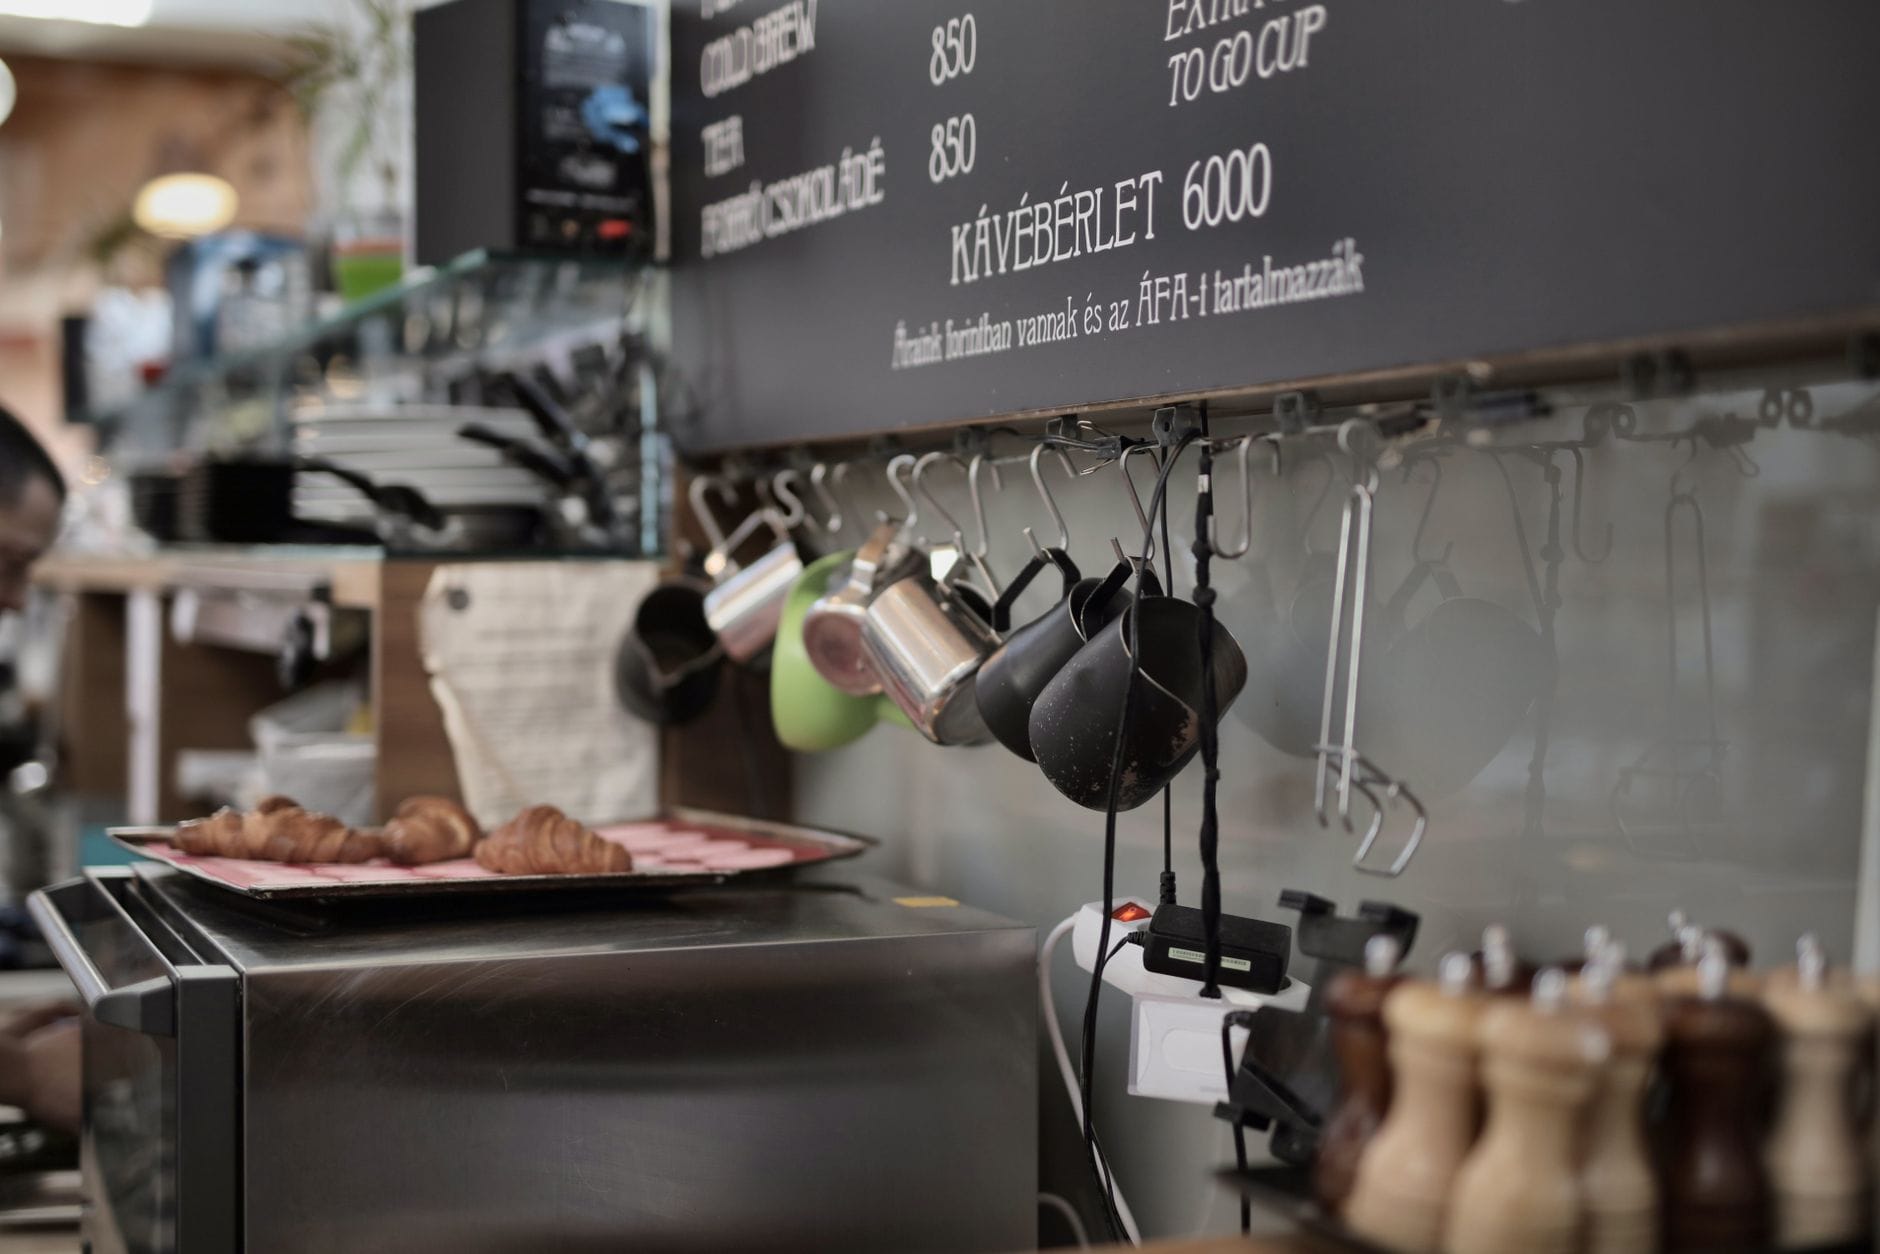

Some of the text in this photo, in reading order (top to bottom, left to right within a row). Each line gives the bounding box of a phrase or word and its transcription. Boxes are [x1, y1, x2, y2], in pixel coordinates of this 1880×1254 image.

[701, 27, 753, 98] COLD
[753, 0, 816, 74] BREW
[930, 13, 977, 86] 850
[1168, 48, 1205, 106] TO
[1209, 31, 1253, 92] GO
[1256, 5, 1327, 78] CUP
[929, 113, 977, 183] 850
[950, 143, 1272, 286] KÁVÉBÉRLET 6000
[945, 312, 1012, 361] forintban
[1016, 296, 1078, 347] vannak
[1083, 292, 1102, 335] és
[1108, 299, 1129, 332] az
[1136, 270, 1208, 327] ÁFA-t
[1213, 237, 1365, 315] tartalmazzák
